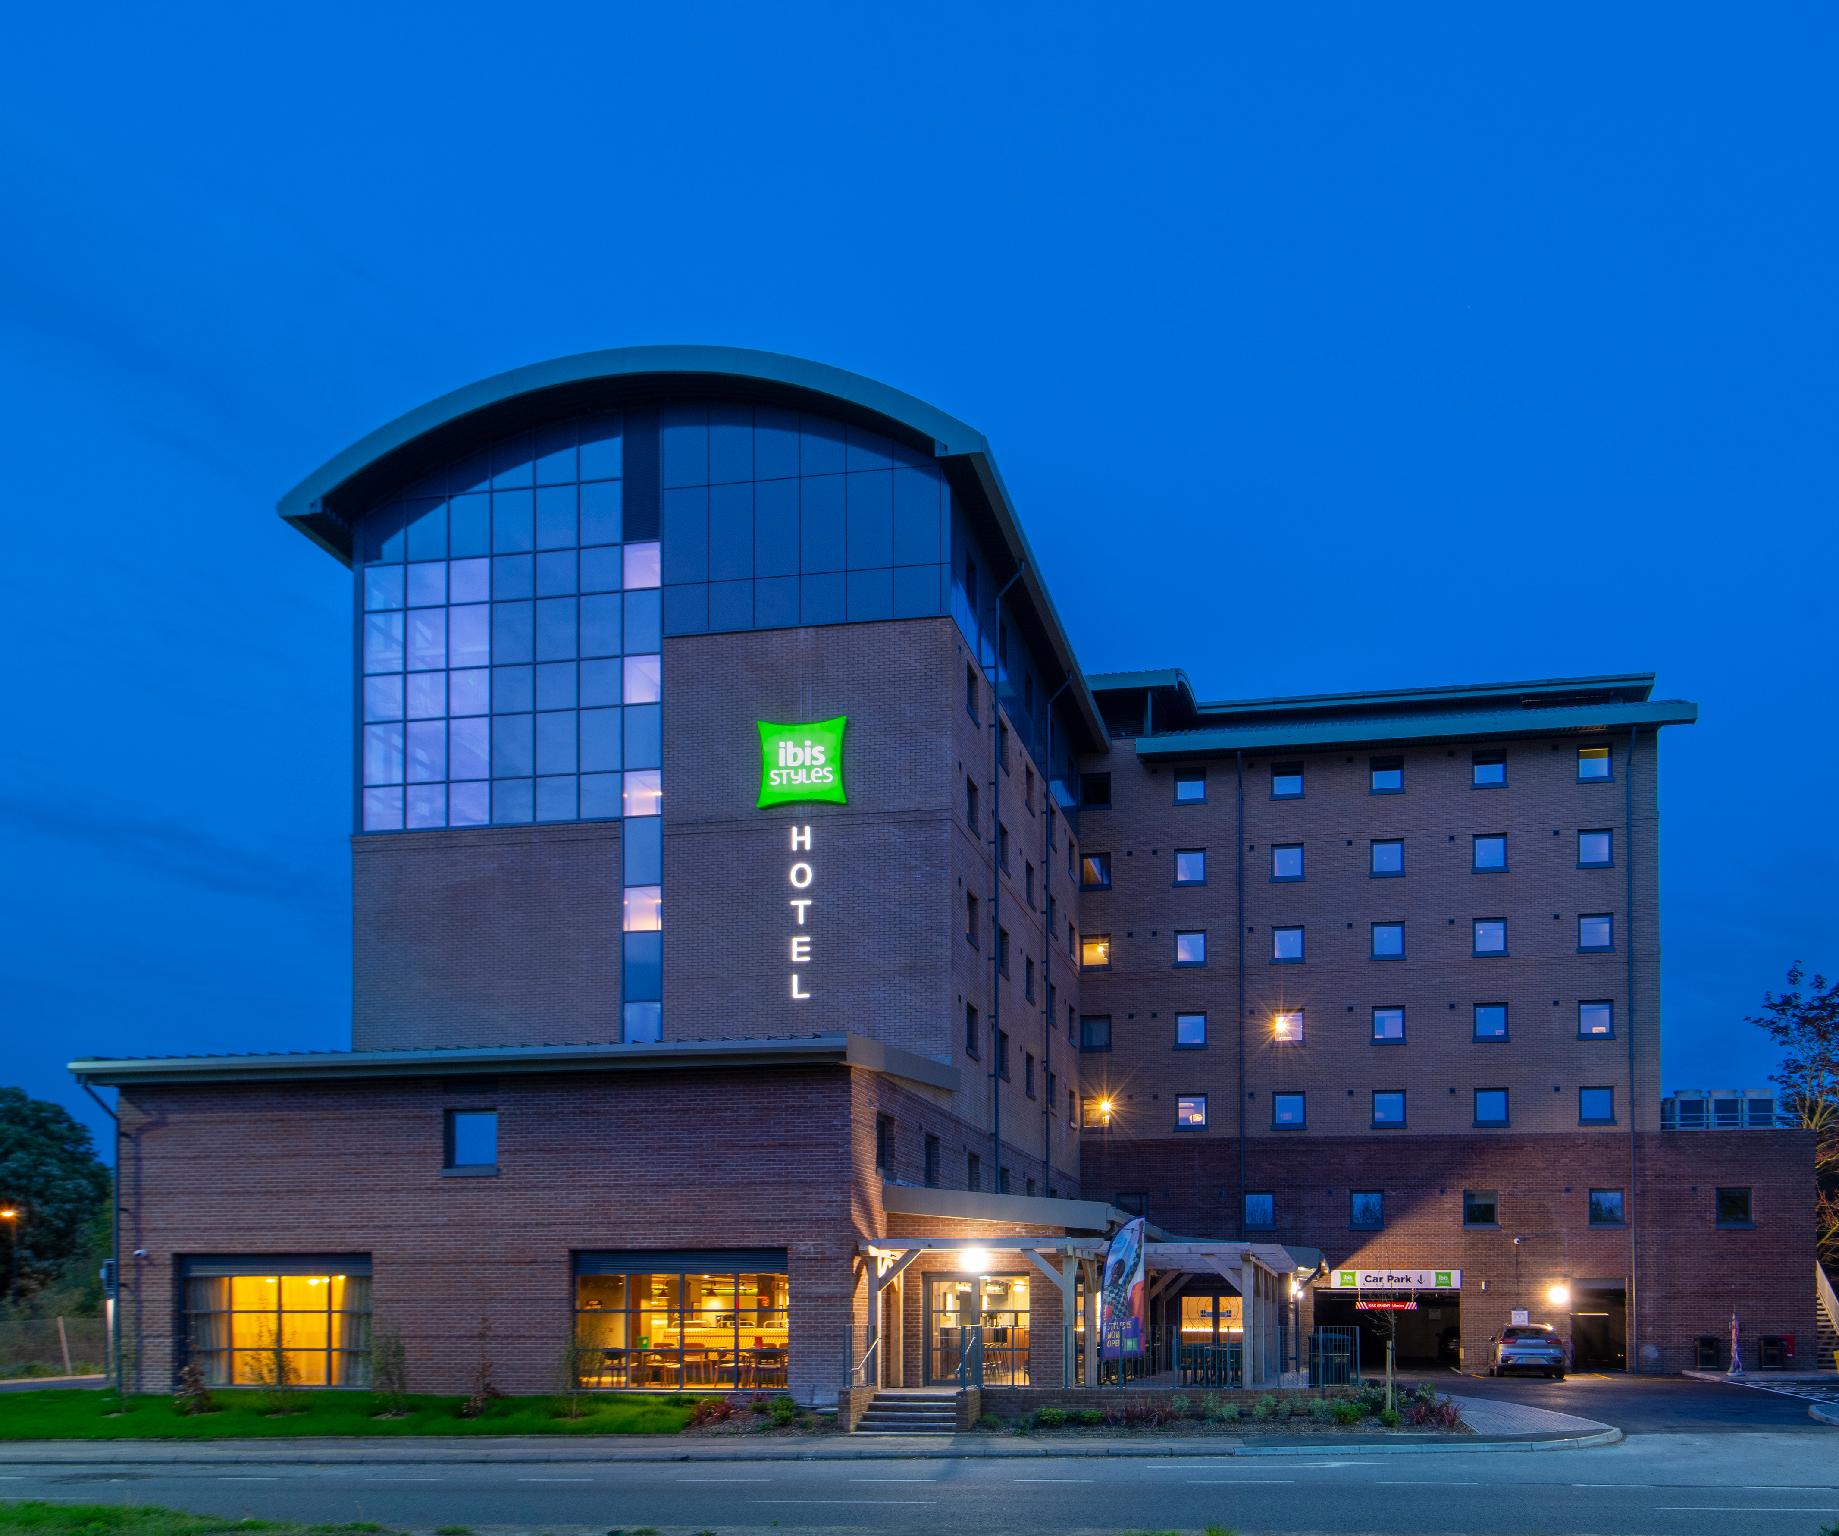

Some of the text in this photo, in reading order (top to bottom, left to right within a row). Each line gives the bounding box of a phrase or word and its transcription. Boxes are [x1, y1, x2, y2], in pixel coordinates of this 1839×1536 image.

[778, 740, 826, 767] ibis
[790, 825, 813, 999] HOTEL
[1364, 1274, 1384, 1283] Car
[1387, 1274, 1412, 1283] Park
